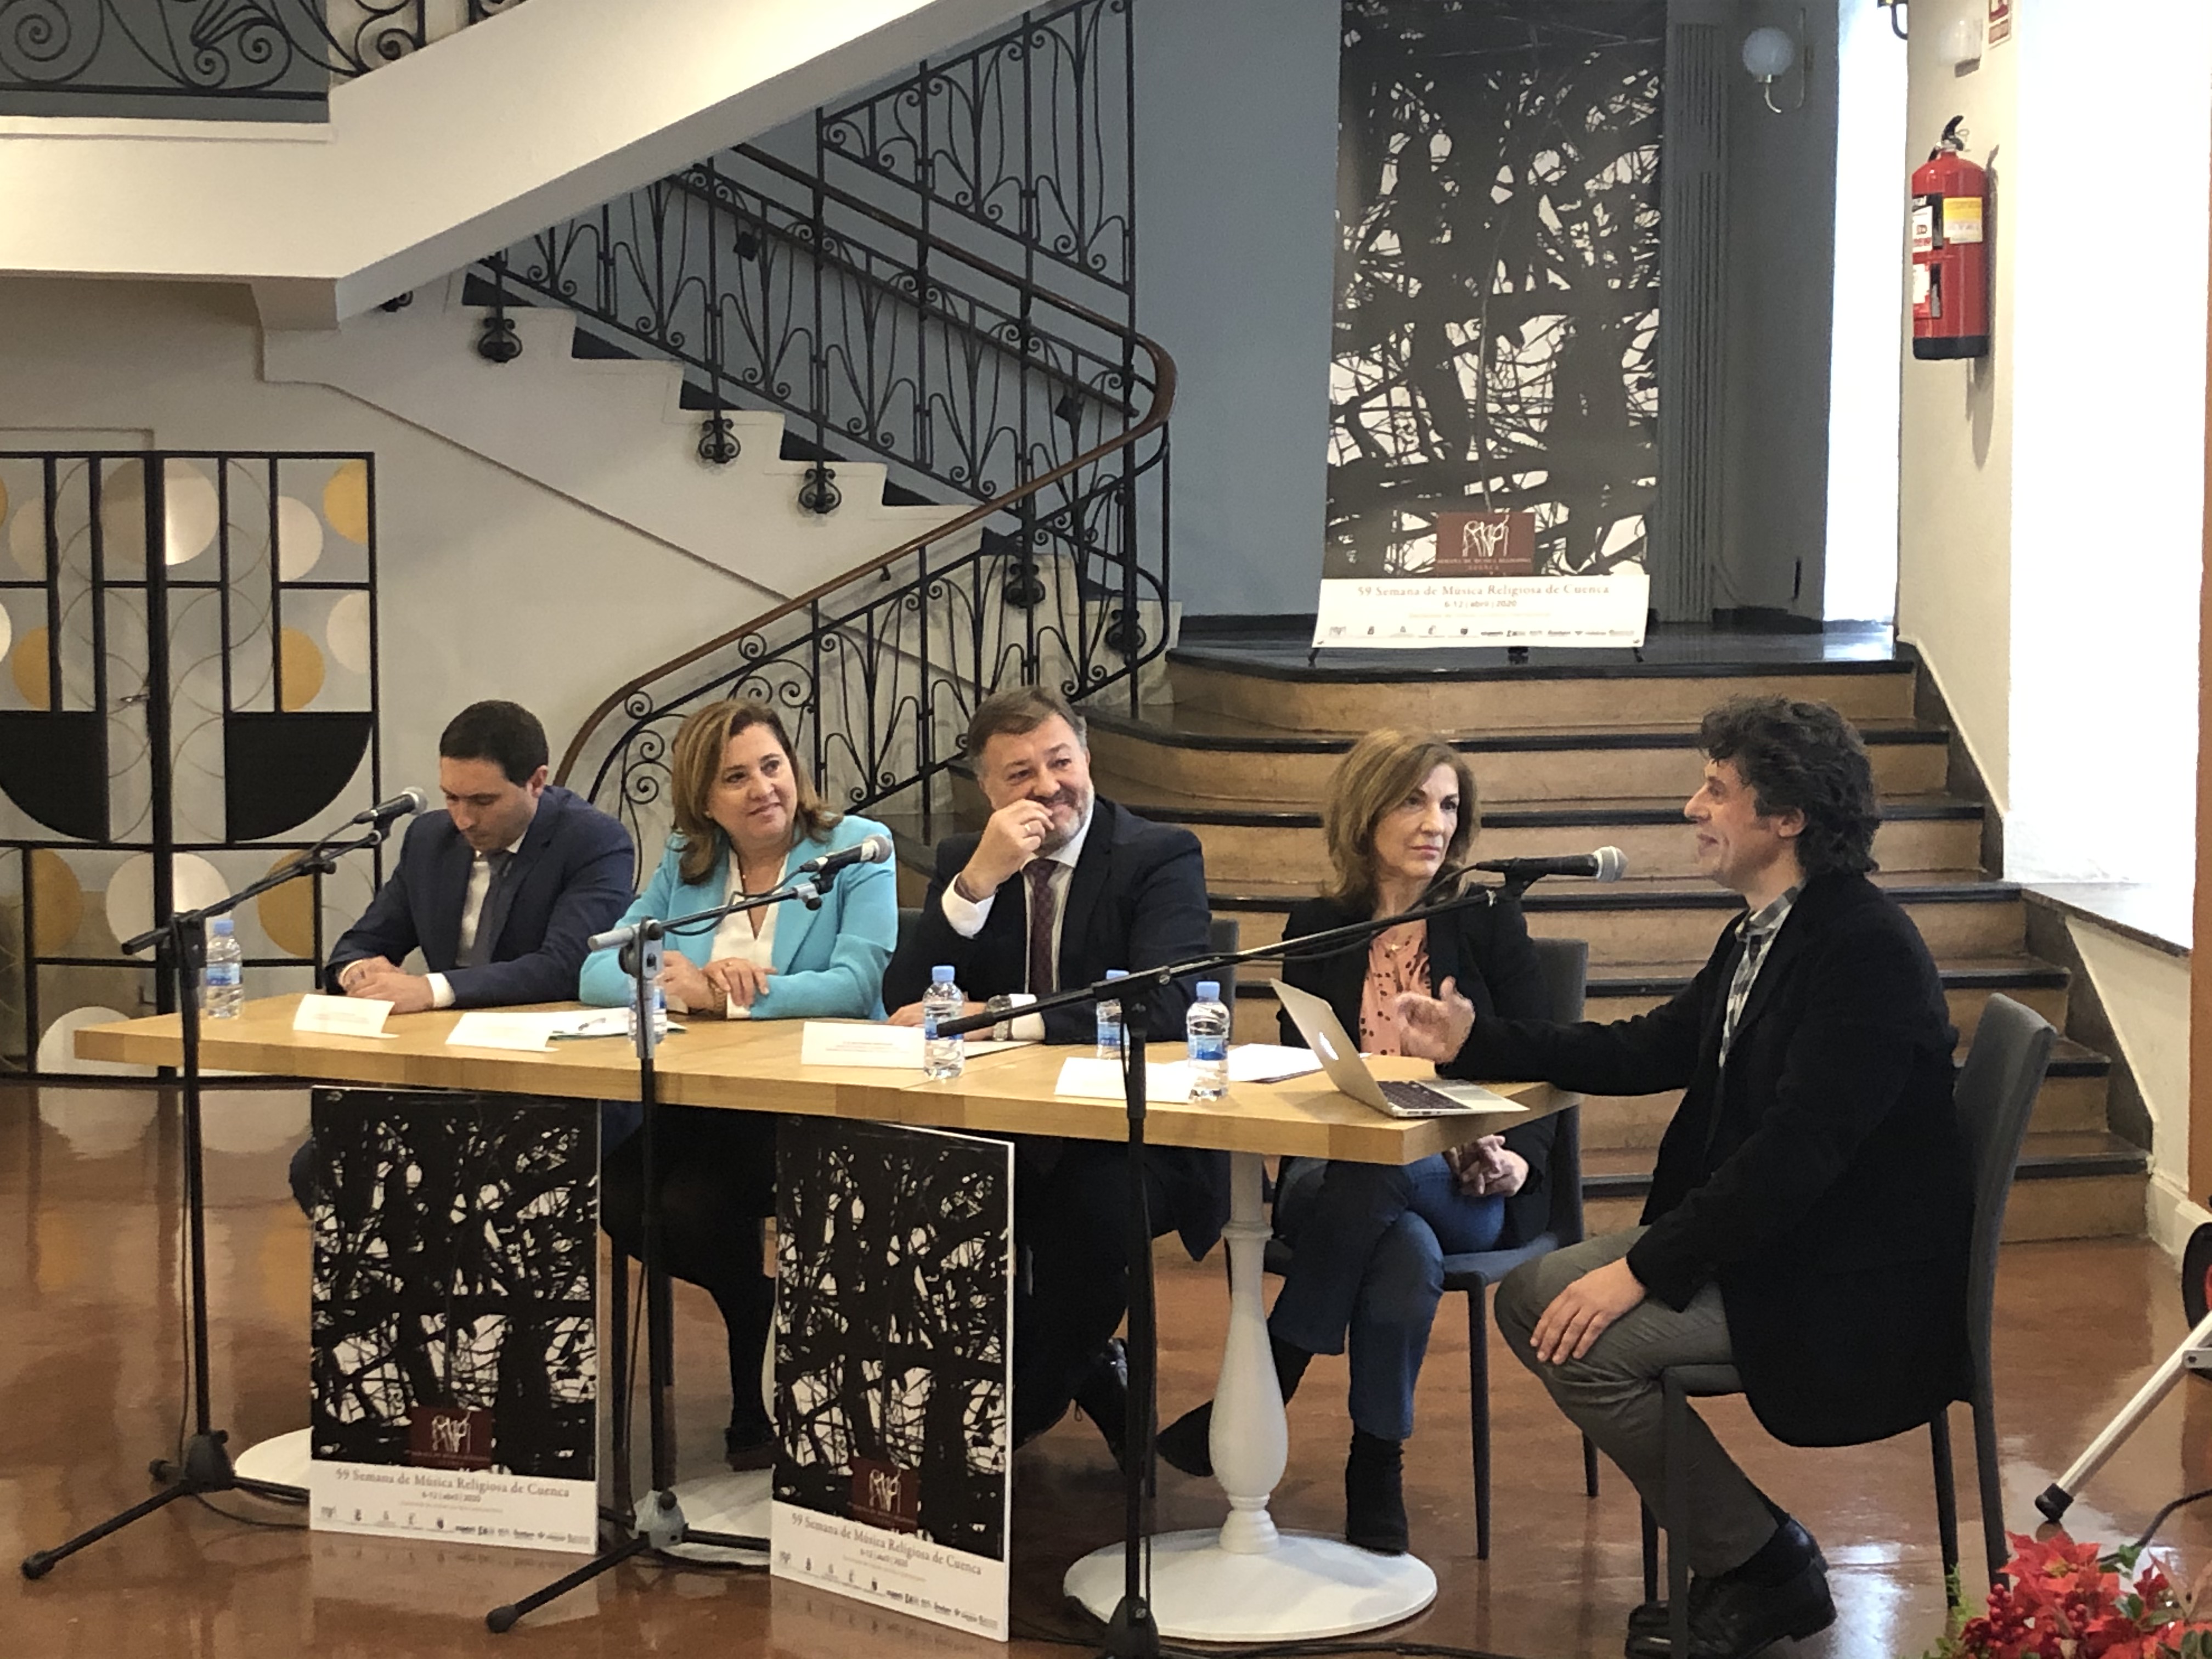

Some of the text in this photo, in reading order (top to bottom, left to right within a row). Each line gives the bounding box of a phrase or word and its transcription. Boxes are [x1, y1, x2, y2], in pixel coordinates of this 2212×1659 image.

[1357, 584, 1610, 597] 59 Semana de Música Religiosa de Cuenca
[335, 1468, 570, 1498] 59 Semana de Música Religiosa de Cuenca
[792, 1513, 803, 1526] 59
[805, 1516, 838, 1536] Semana
[840, 1525, 851, 1539] de
[888, 1538, 930, 1561] Religiosa
[933, 1550, 945, 1564] de
[946, 1554, 982, 1576] Cuenca
